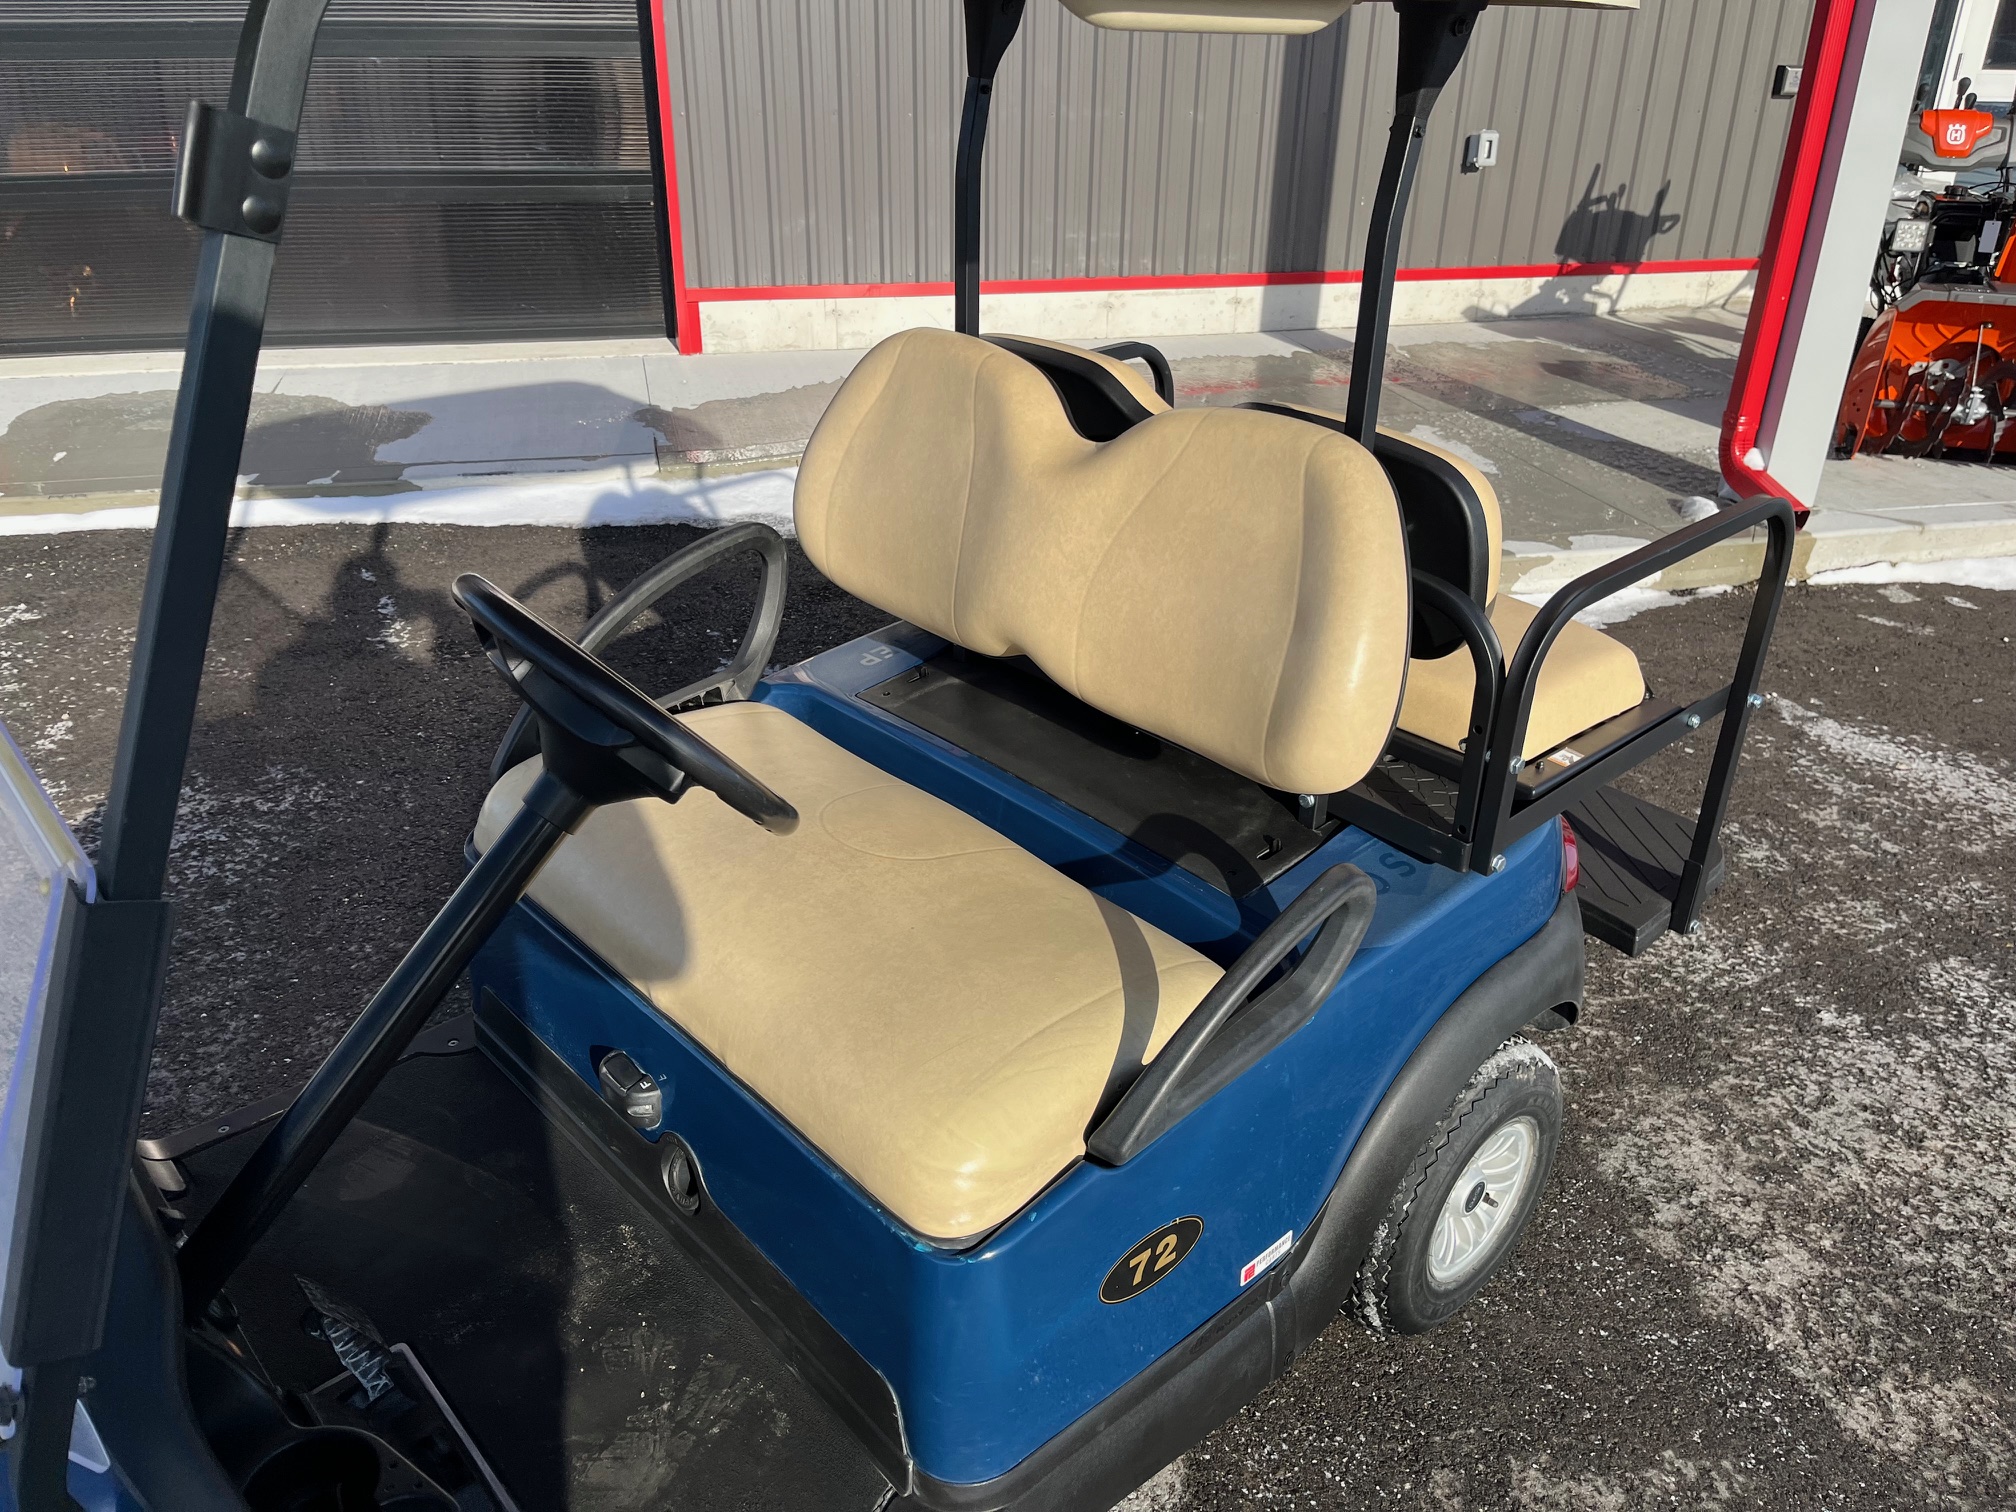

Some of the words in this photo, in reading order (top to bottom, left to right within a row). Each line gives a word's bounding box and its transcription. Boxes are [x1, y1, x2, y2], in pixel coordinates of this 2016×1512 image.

[640, 1081, 651, 1089] F
[658, 1073, 667, 1081] F
[1129, 1234, 1178, 1286] 72
[1256, 1234, 1291, 1267] PERFORMANCE
